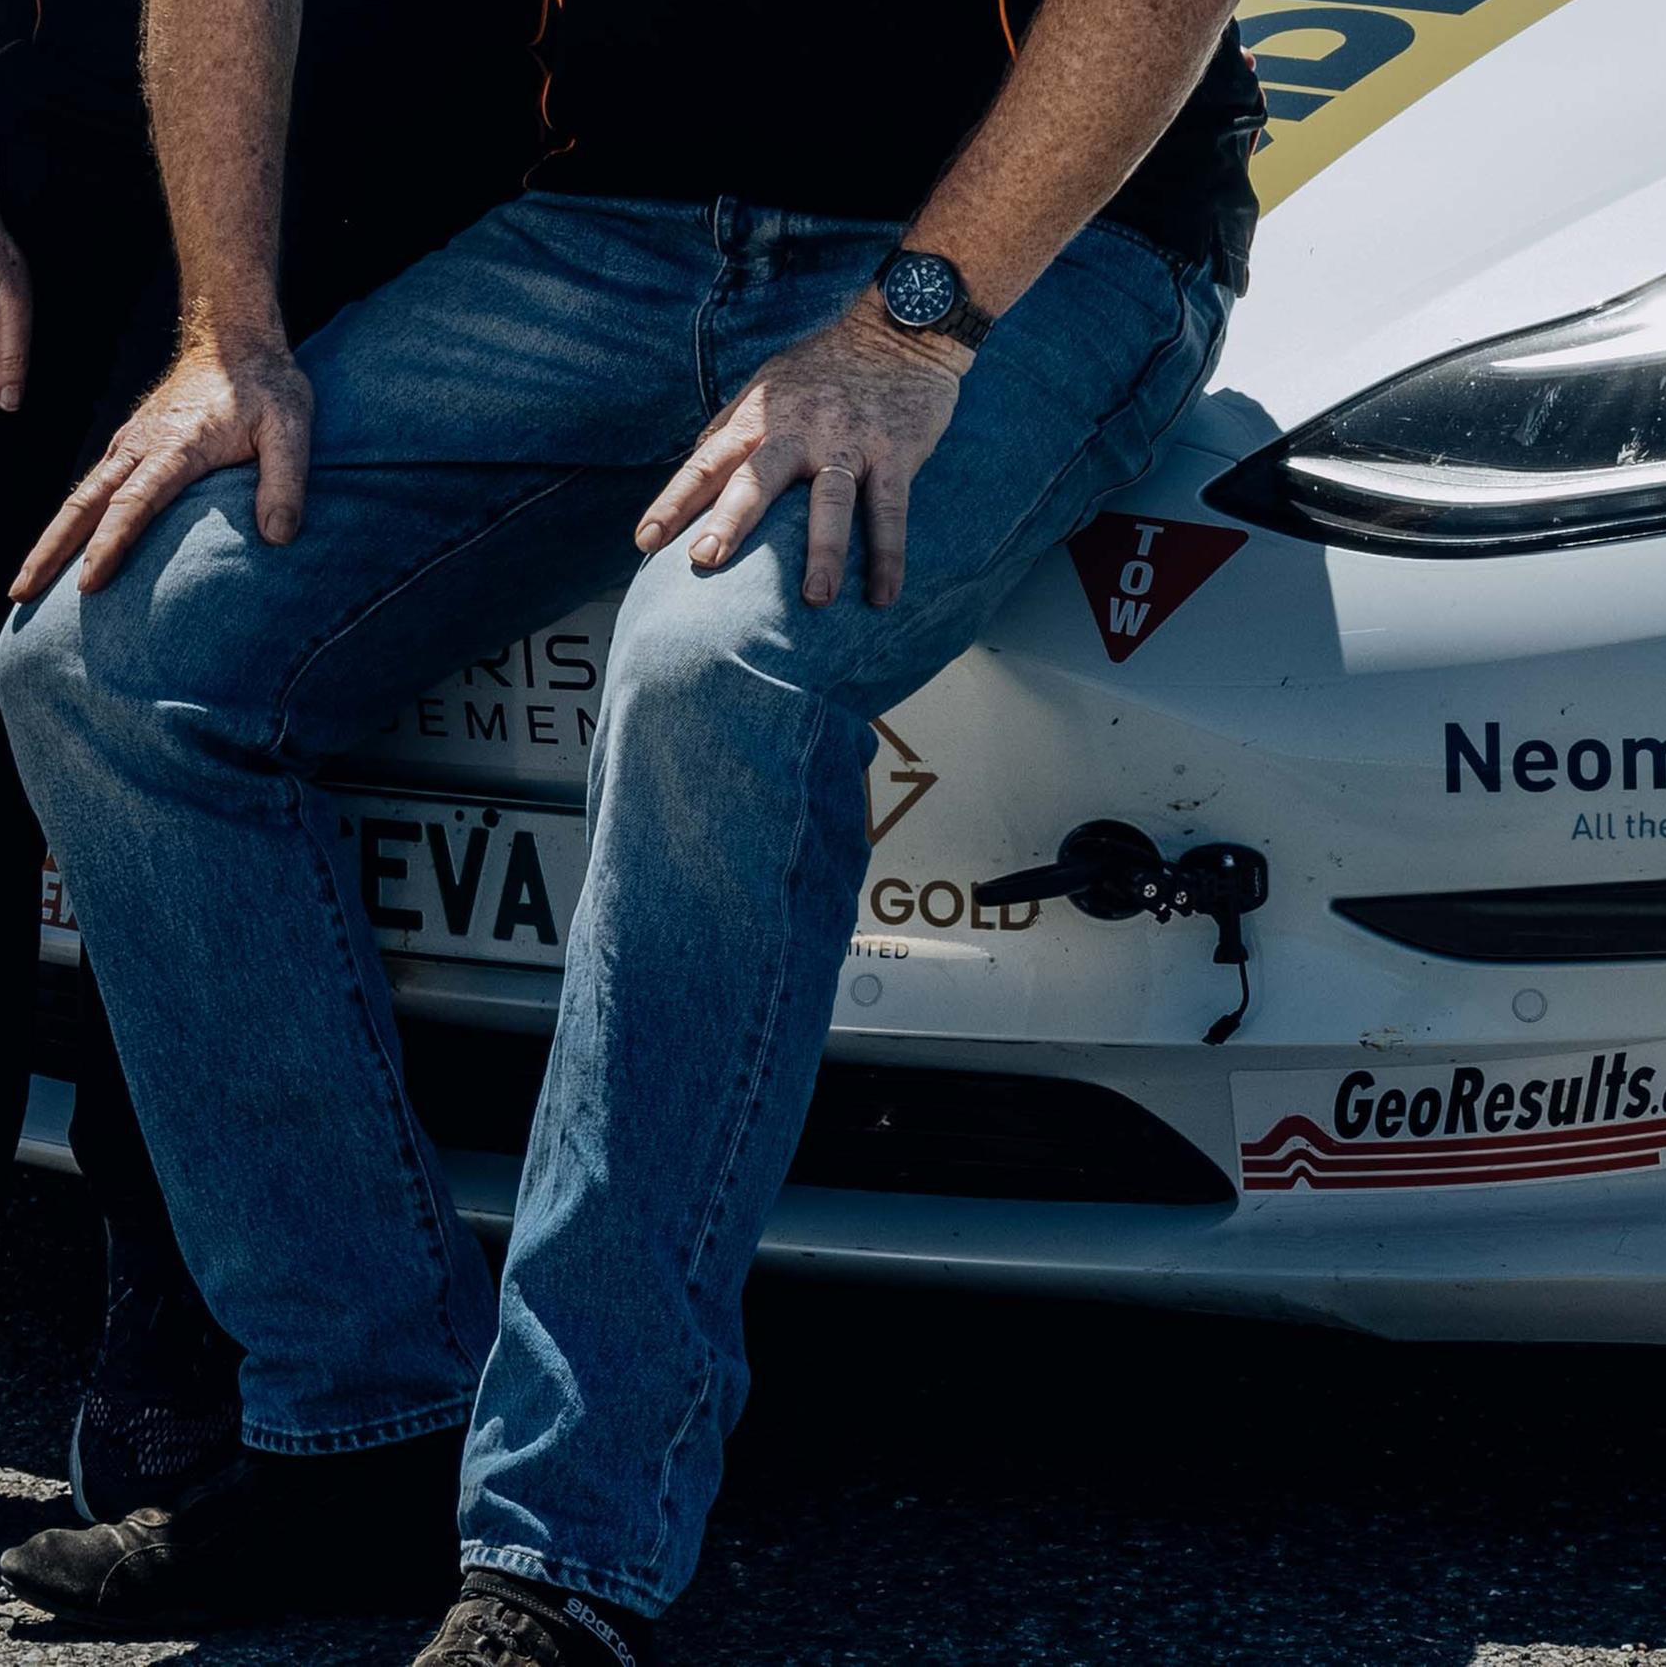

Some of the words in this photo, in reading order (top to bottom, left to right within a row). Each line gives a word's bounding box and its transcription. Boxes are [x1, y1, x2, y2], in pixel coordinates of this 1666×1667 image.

[1109, 523, 1165, 637] TOW
[1571, 812, 1616, 841] All
[341, 816, 560, 946] EVA
[848, 938, 910, 960] ITED
